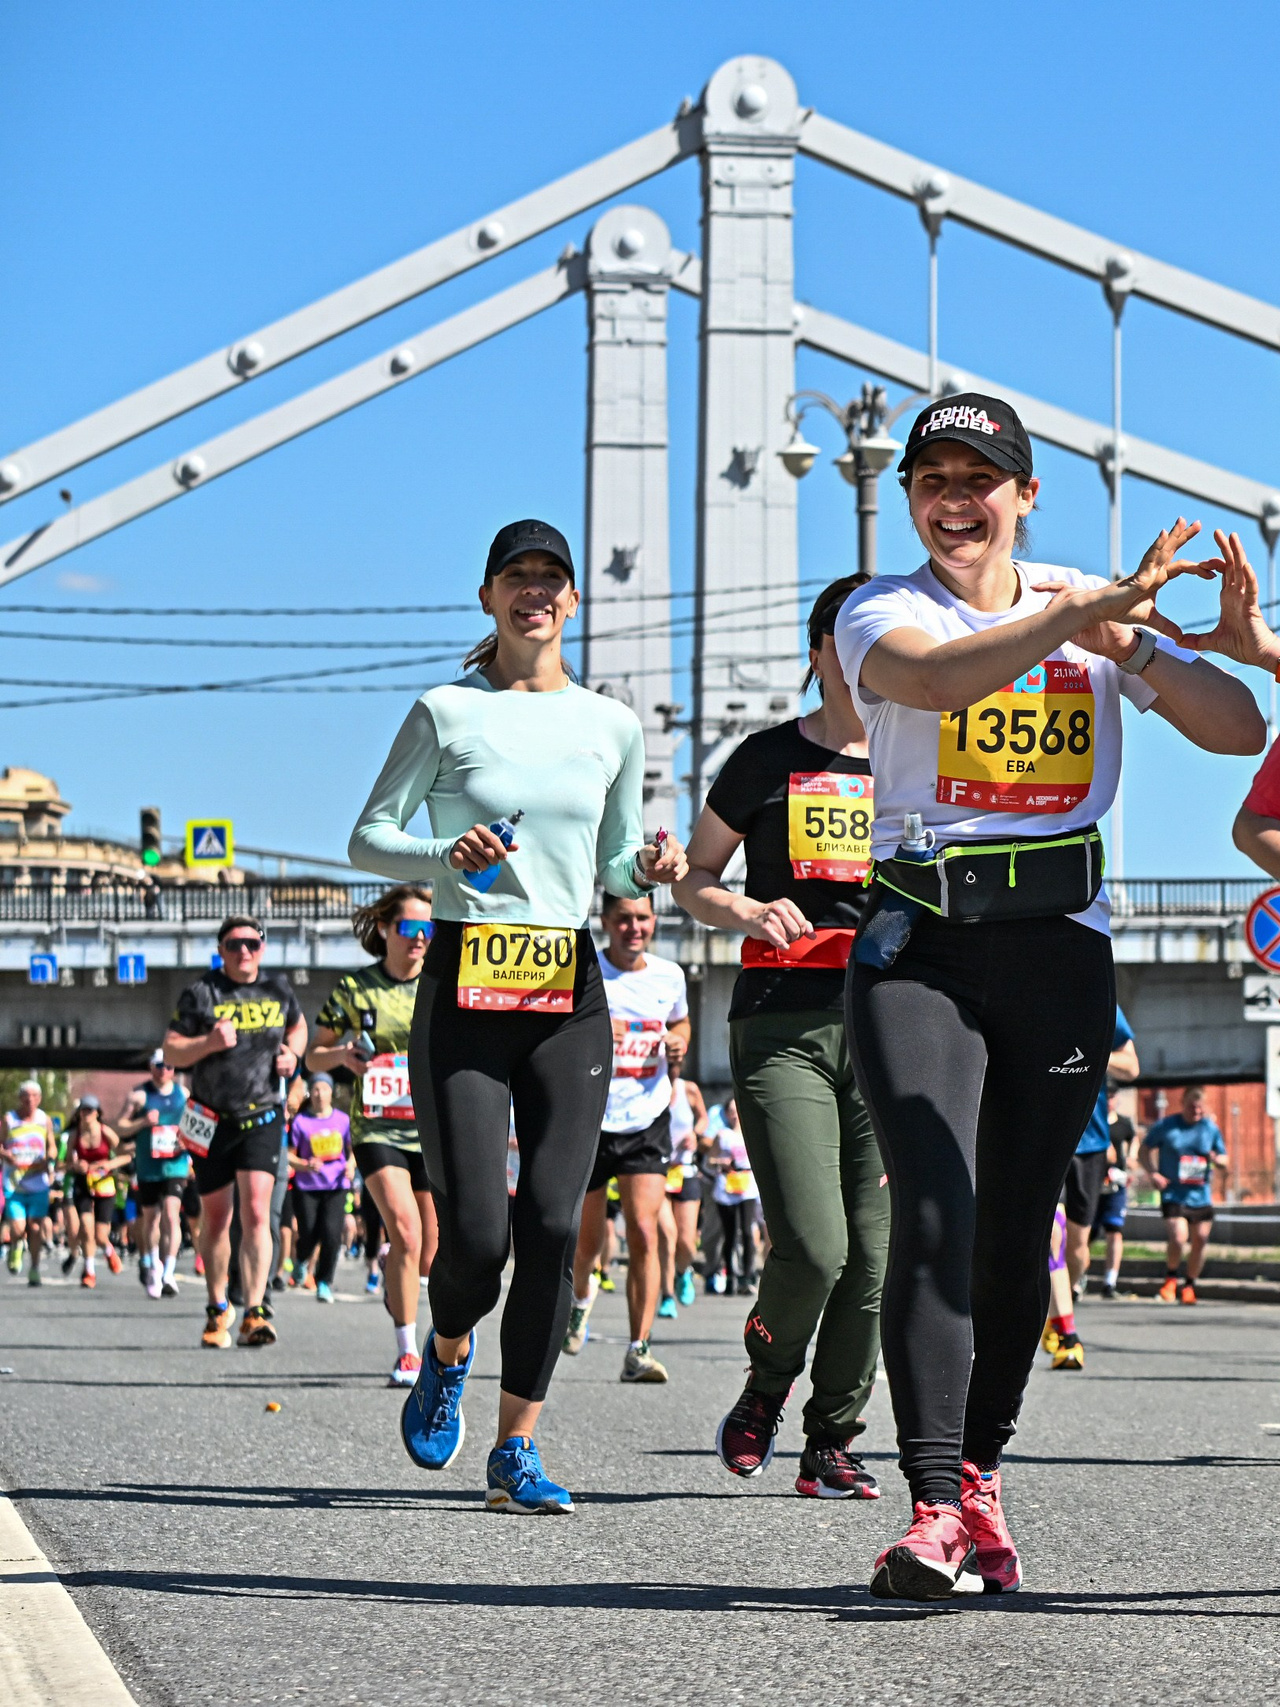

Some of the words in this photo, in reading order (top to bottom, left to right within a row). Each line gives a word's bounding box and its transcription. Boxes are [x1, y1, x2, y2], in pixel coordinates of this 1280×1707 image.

[930, 405, 989, 422] ГОНКА
[920, 416, 995, 437] ГЕРОЕВ
[1063, 681, 1084, 689] 2024
[949, 706, 1091, 756] 13568
[1006, 759, 1036, 773] ЕВА
[950, 780, 968, 803] F
[816, 842, 869, 854] ЕЛИЗАВЕ
[466, 933, 574, 969] 10780
[492, 969, 546, 981] ВАЛЕРИЯ
[468, 987, 482, 1008] F
[1048, 1065, 1091, 1074] DEMIX
